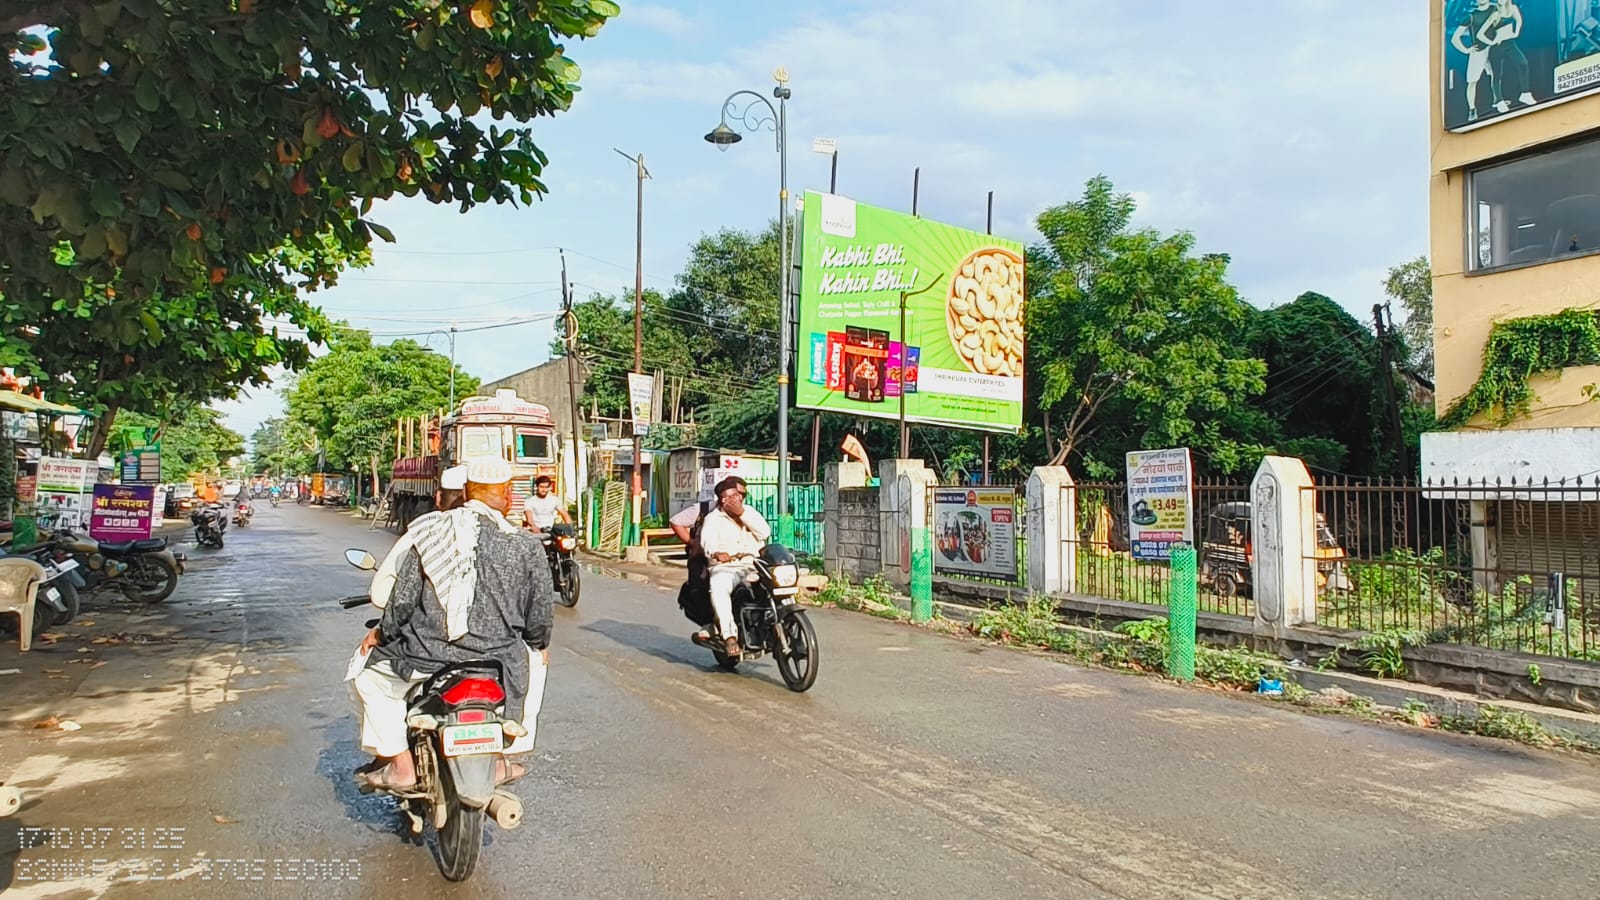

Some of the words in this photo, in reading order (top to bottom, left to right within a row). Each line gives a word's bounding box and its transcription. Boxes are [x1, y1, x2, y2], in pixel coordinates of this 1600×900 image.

[820, 245, 871, 268] Kabhi
[819, 272, 870, 295] Kahin
[1157, 499, 1177, 511] 3.49
